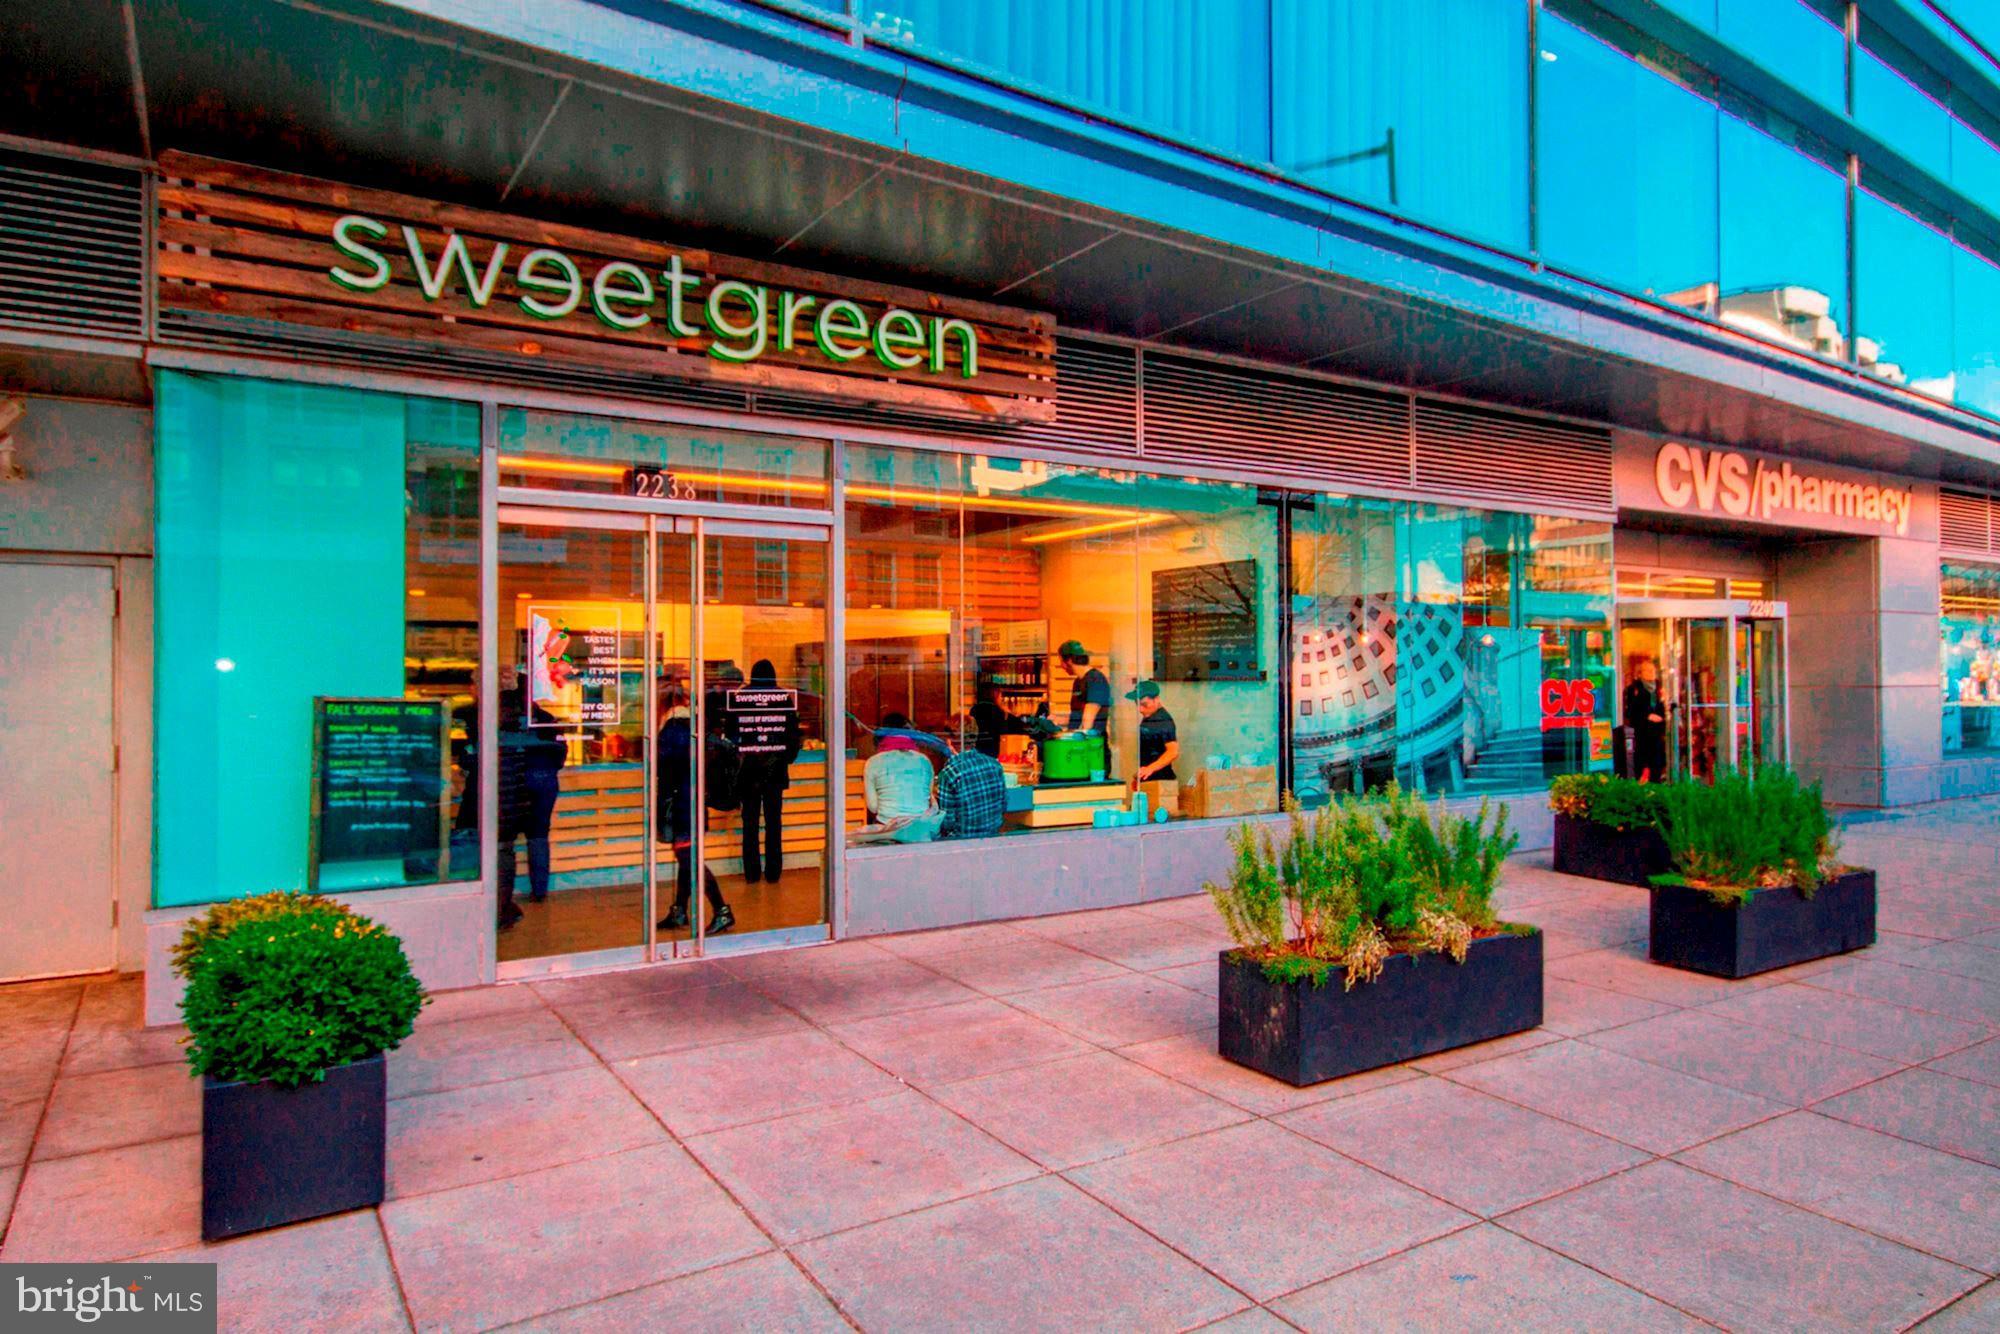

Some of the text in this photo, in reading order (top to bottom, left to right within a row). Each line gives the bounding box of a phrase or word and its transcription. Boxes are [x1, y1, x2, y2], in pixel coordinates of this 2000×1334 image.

[328, 214, 979, 379] sweetgreen
[636, 473, 696, 500] 2238
[1655, 442, 1912, 536] CVS/pharmacy
[1750, 600, 1775, 617] 2240
[583, 636, 615, 644] TASTES
[593, 646, 615, 654] BEST
[588, 656, 615, 665] WHEN
[580, 678, 615, 687] SEASON
[735, 693, 788, 702] sweetgreen
[1540, 679, 1595, 715] CVS
[597, 703, 615, 711] OUR
[591, 712, 615, 720] MENU
